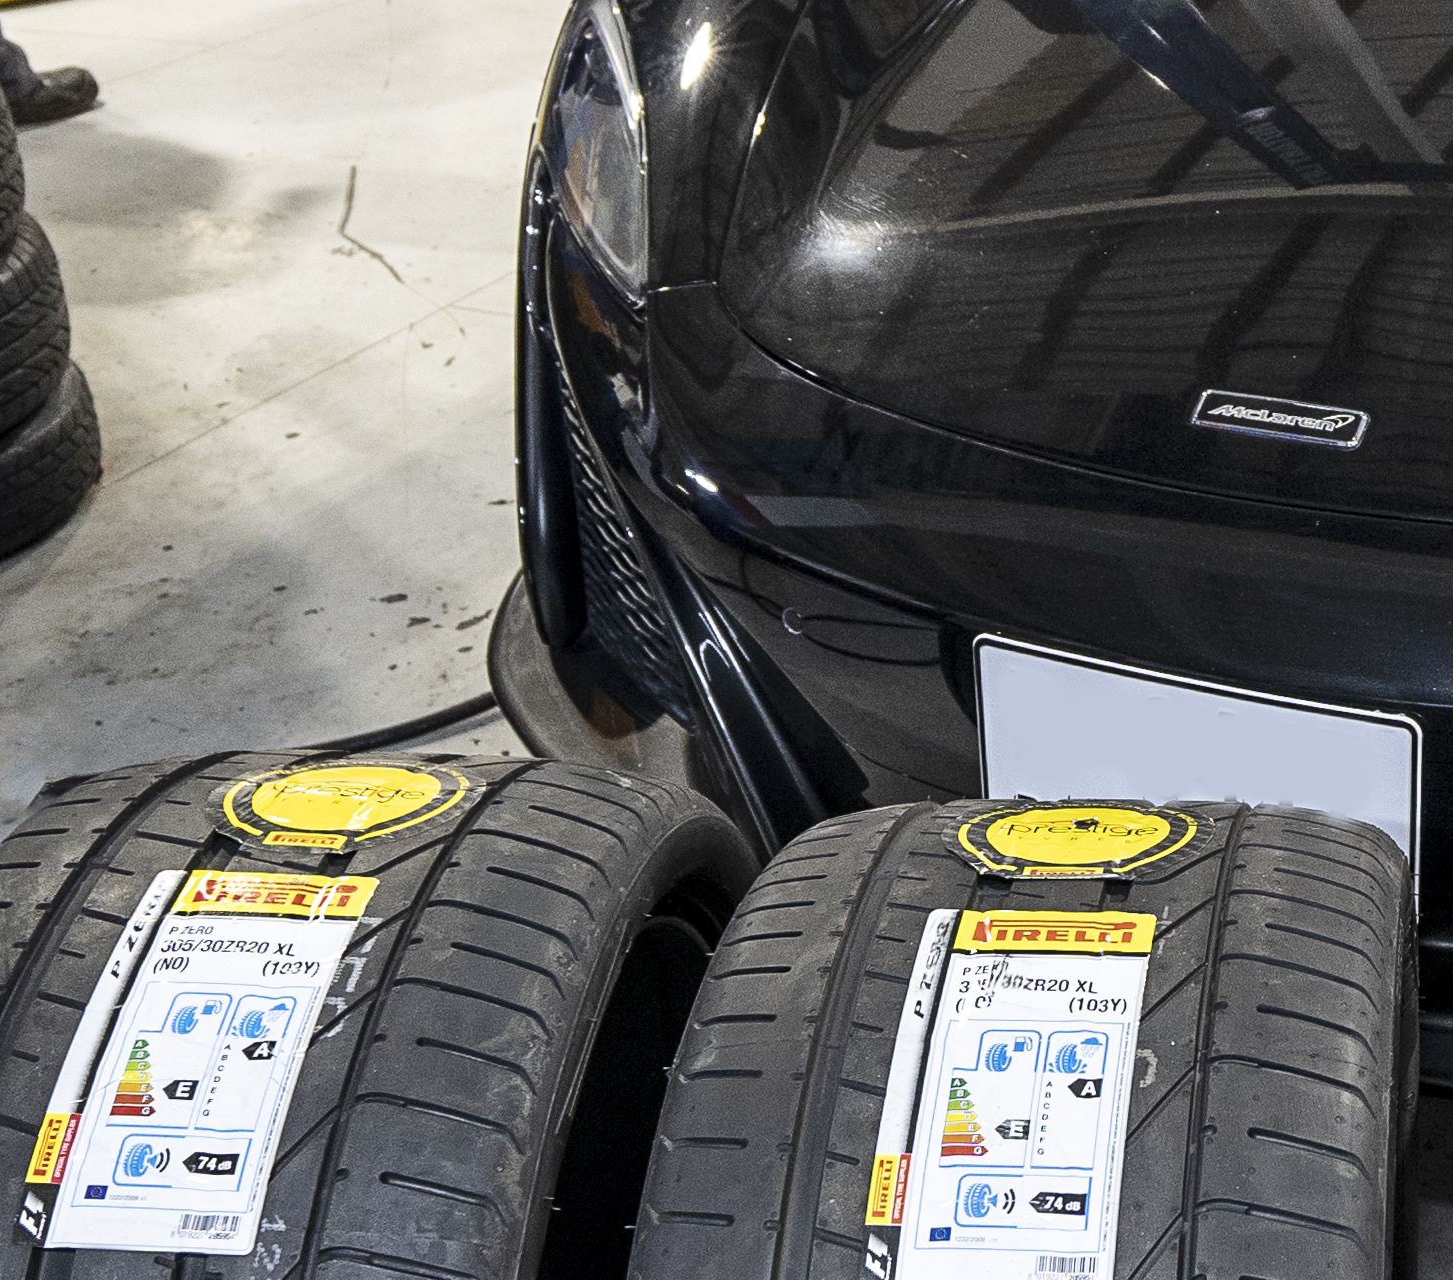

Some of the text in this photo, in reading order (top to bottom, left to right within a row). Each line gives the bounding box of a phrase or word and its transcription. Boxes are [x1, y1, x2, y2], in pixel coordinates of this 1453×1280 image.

[1207, 404, 1337, 432] McLaren
[274, 784, 426, 802] prestige
[273, 835, 338, 845] PIRELLI
[192, 879, 359, 908] PIRELLI
[169, 926, 214, 935] P ZERO
[972, 920, 1138, 943] PIRELLI
[160, 939, 295, 957] 305/30ZR20 XL
[262, 960, 320, 978] (103Y)
[963, 967, 971, 975] P
[959, 979, 1098, 994] 35/30ZR20 XL
[914, 1000, 924, 1019] P
[1069, 997, 1128, 1014] (103Y)
[252, 1043, 270, 1058] A
[175, 1082, 193, 1097] E
[1080, 1081, 1096, 1096] A
[1009, 1121, 1024, 1137] E
[33, 1119, 62, 1176] PIRELLI
[197, 1156, 233, 1170] 74 dB
[872, 1159, 893, 1217] PIRELLI
[1044, 1197, 1081, 1211] 74 dB
